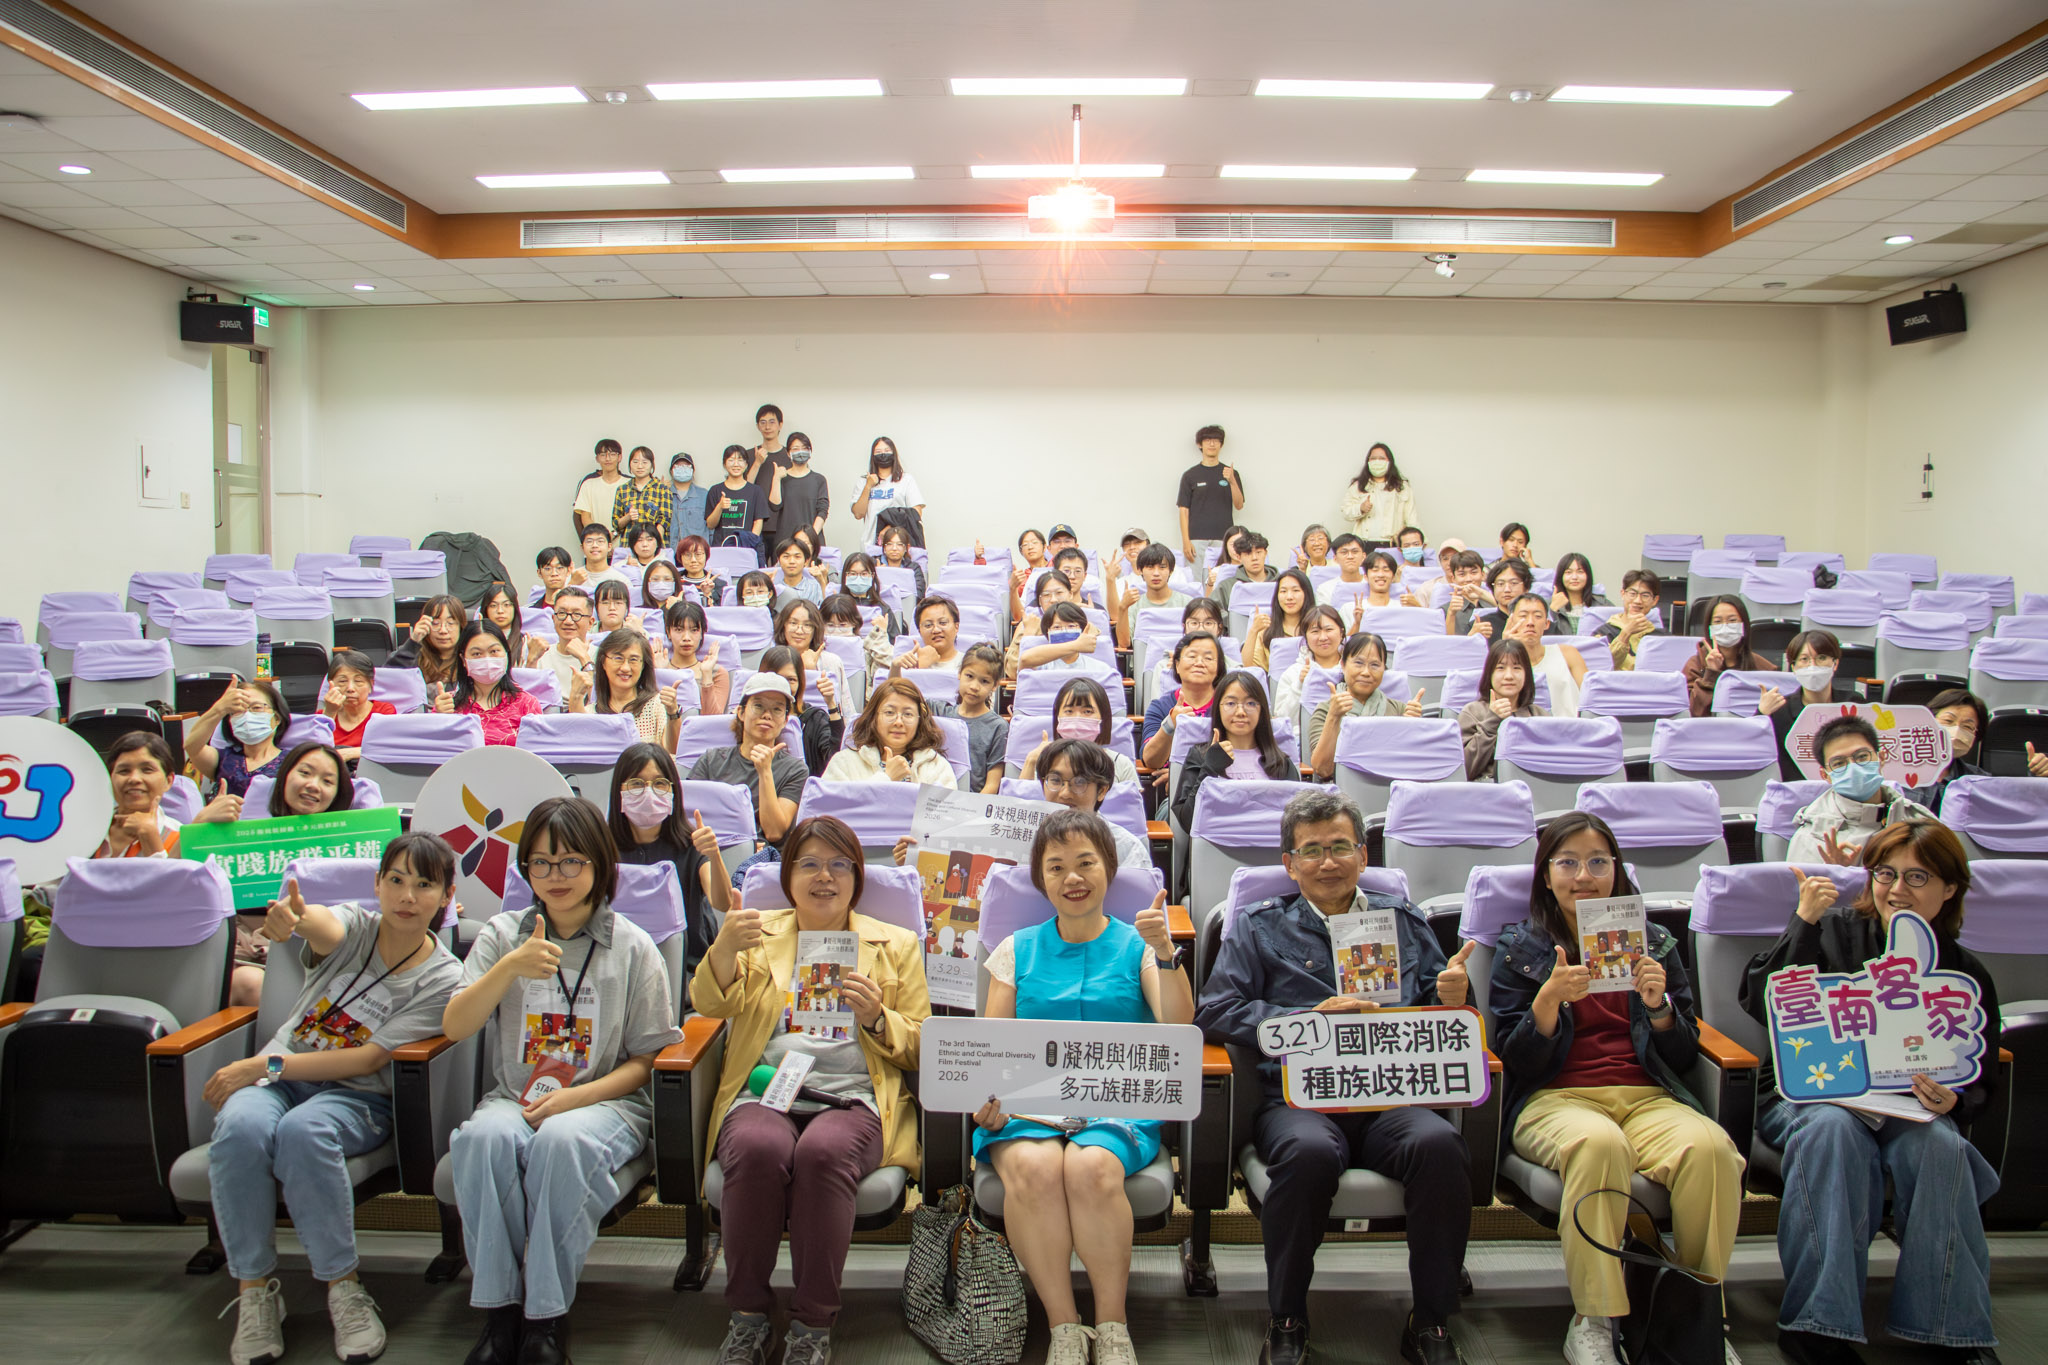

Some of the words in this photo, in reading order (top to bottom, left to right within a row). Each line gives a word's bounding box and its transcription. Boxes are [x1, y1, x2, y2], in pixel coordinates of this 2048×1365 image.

[219, 320, 243, 330] SUGAR
[1796, 726, 1947, 765] 臺家讚!
[1771, 954, 1973, 1041] 臺南客家
[953, 1040, 966, 1048] 3rd
[1266, 1019, 1319, 1049] 3.21
[1334, 1018, 1471, 1056] 國際消除
[938, 1049, 961, 1057] Ethnic
[976, 1050, 1004, 1058] Cultural
[1005, 1051, 1036, 1060] Diversity
[938, 1058, 953, 1066] Film
[954, 1059, 981, 1067] Festival
[938, 1070, 969, 1082] 2026
[1301, 1062, 1471, 1101] 種族歧視日
[534, 1082, 556, 1093] STAF
[1060, 1076, 1183, 1105] 多元族群影展
